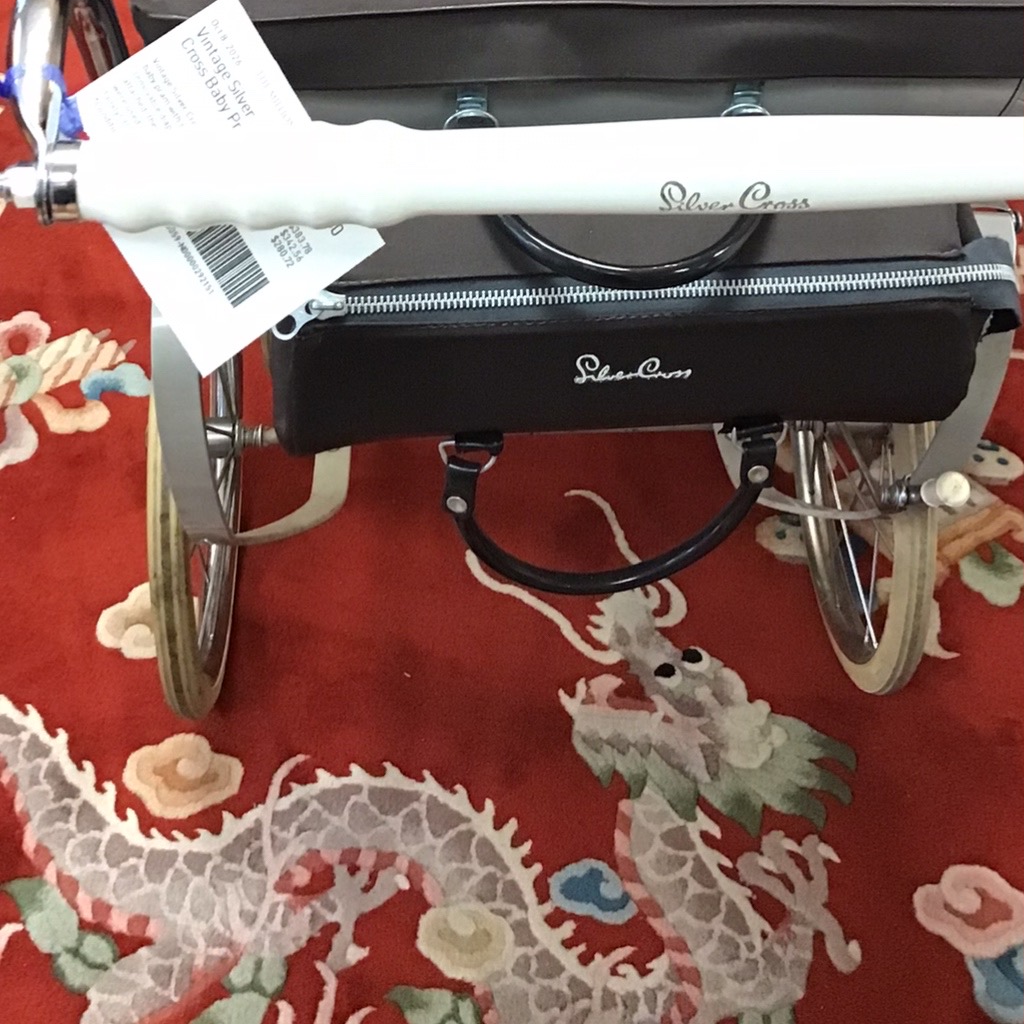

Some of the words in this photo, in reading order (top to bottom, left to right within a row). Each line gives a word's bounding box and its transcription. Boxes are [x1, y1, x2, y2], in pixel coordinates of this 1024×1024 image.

[180, 36, 208, 78] Cross
[203, 75, 231, 113] Baby
[196, 25, 233, 81] Vintage
[227, 79, 256, 118] Silver
[659, 181, 735, 212] Silver
[738, 181, 811, 211] Cross
